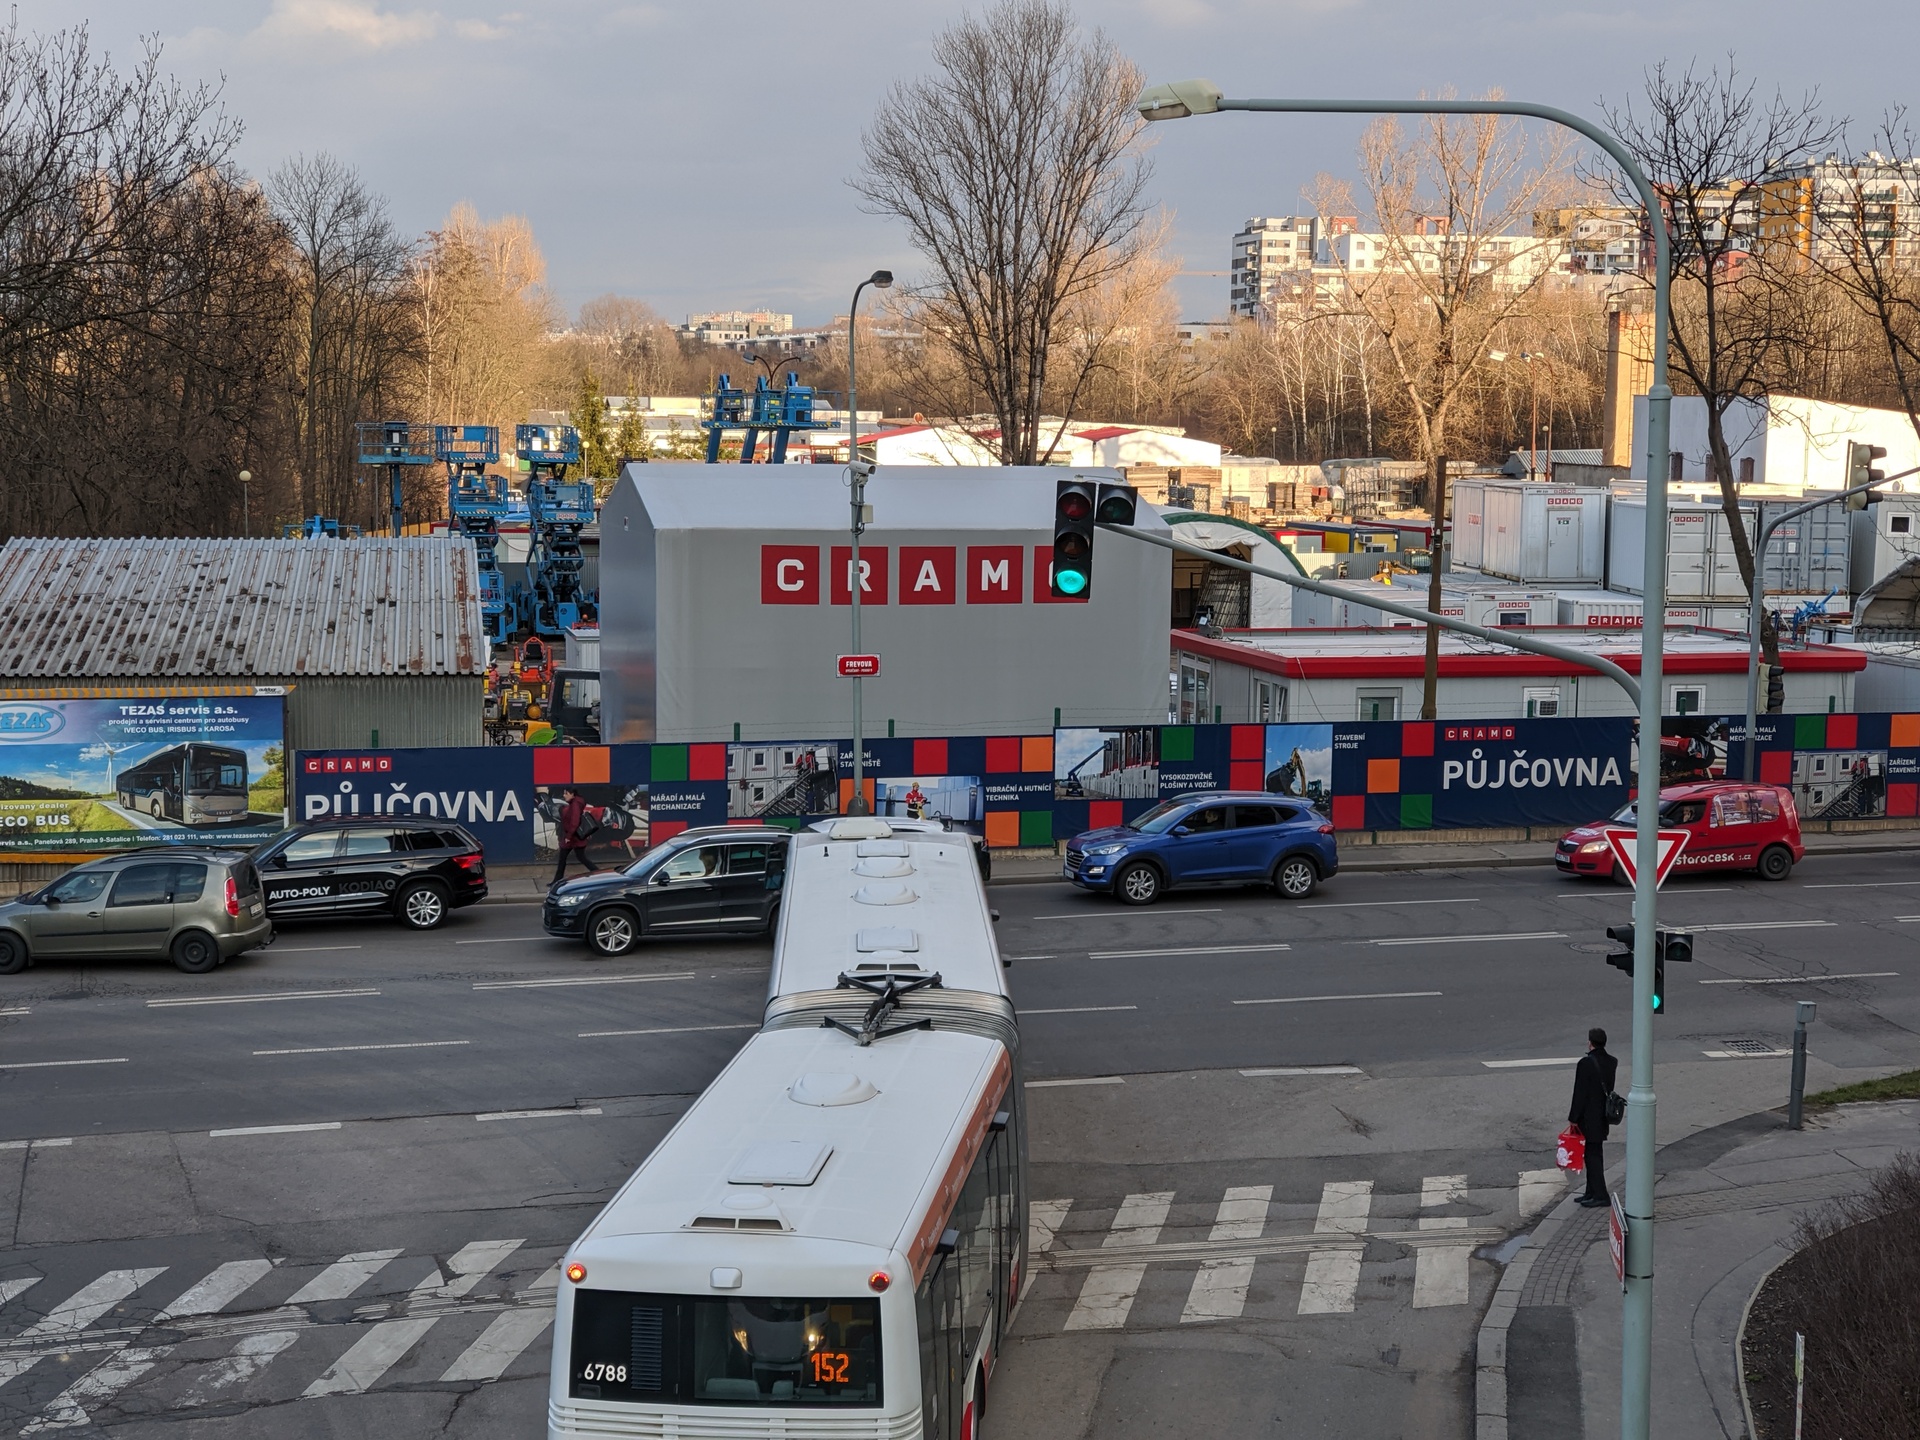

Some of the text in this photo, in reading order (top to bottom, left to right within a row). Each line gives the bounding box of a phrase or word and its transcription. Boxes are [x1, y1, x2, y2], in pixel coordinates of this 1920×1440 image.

[777, 558, 1054, 592] CRAM
[845, 660, 873, 668] FREYOVA
[119, 705, 238, 716] TEZAS servis a.s.
[0, 711, 54, 732] EZAS
[217, 716, 250, 725] autobusy
[148, 726, 166, 734] BUS,
[1448, 730, 1512, 738] CRAMO
[1759, 725, 1777, 733] MALÁ
[1334, 732, 1366, 741] STAVEBNÍ
[309, 760, 388, 770] CRAMO
[1889, 757, 1917, 766] ZAŘÍZENÍ
[1443, 748, 1623, 790] PŮJČOVNA
[1160, 772, 1213, 781] VYSOKOZDVIŽNÉ
[985, 783, 1018, 793] VIBRAČNÍ
[1024, 782, 1052, 792] HUTNÍCÍ
[1160, 780, 1188, 789] PLOŠINY
[1194, 779, 1217, 788] VOZÍKY
[650, 792, 706, 802] NÁŘADÍ A MALÁ
[650, 803, 702, 811] MECHANIZACE
[35, 814, 70, 826] BUS
[269, 878, 397, 900] AUTO-POLY KODIAQ
[810, 1352, 849, 1383] 152
[583, 1363, 627, 1383] 6788
